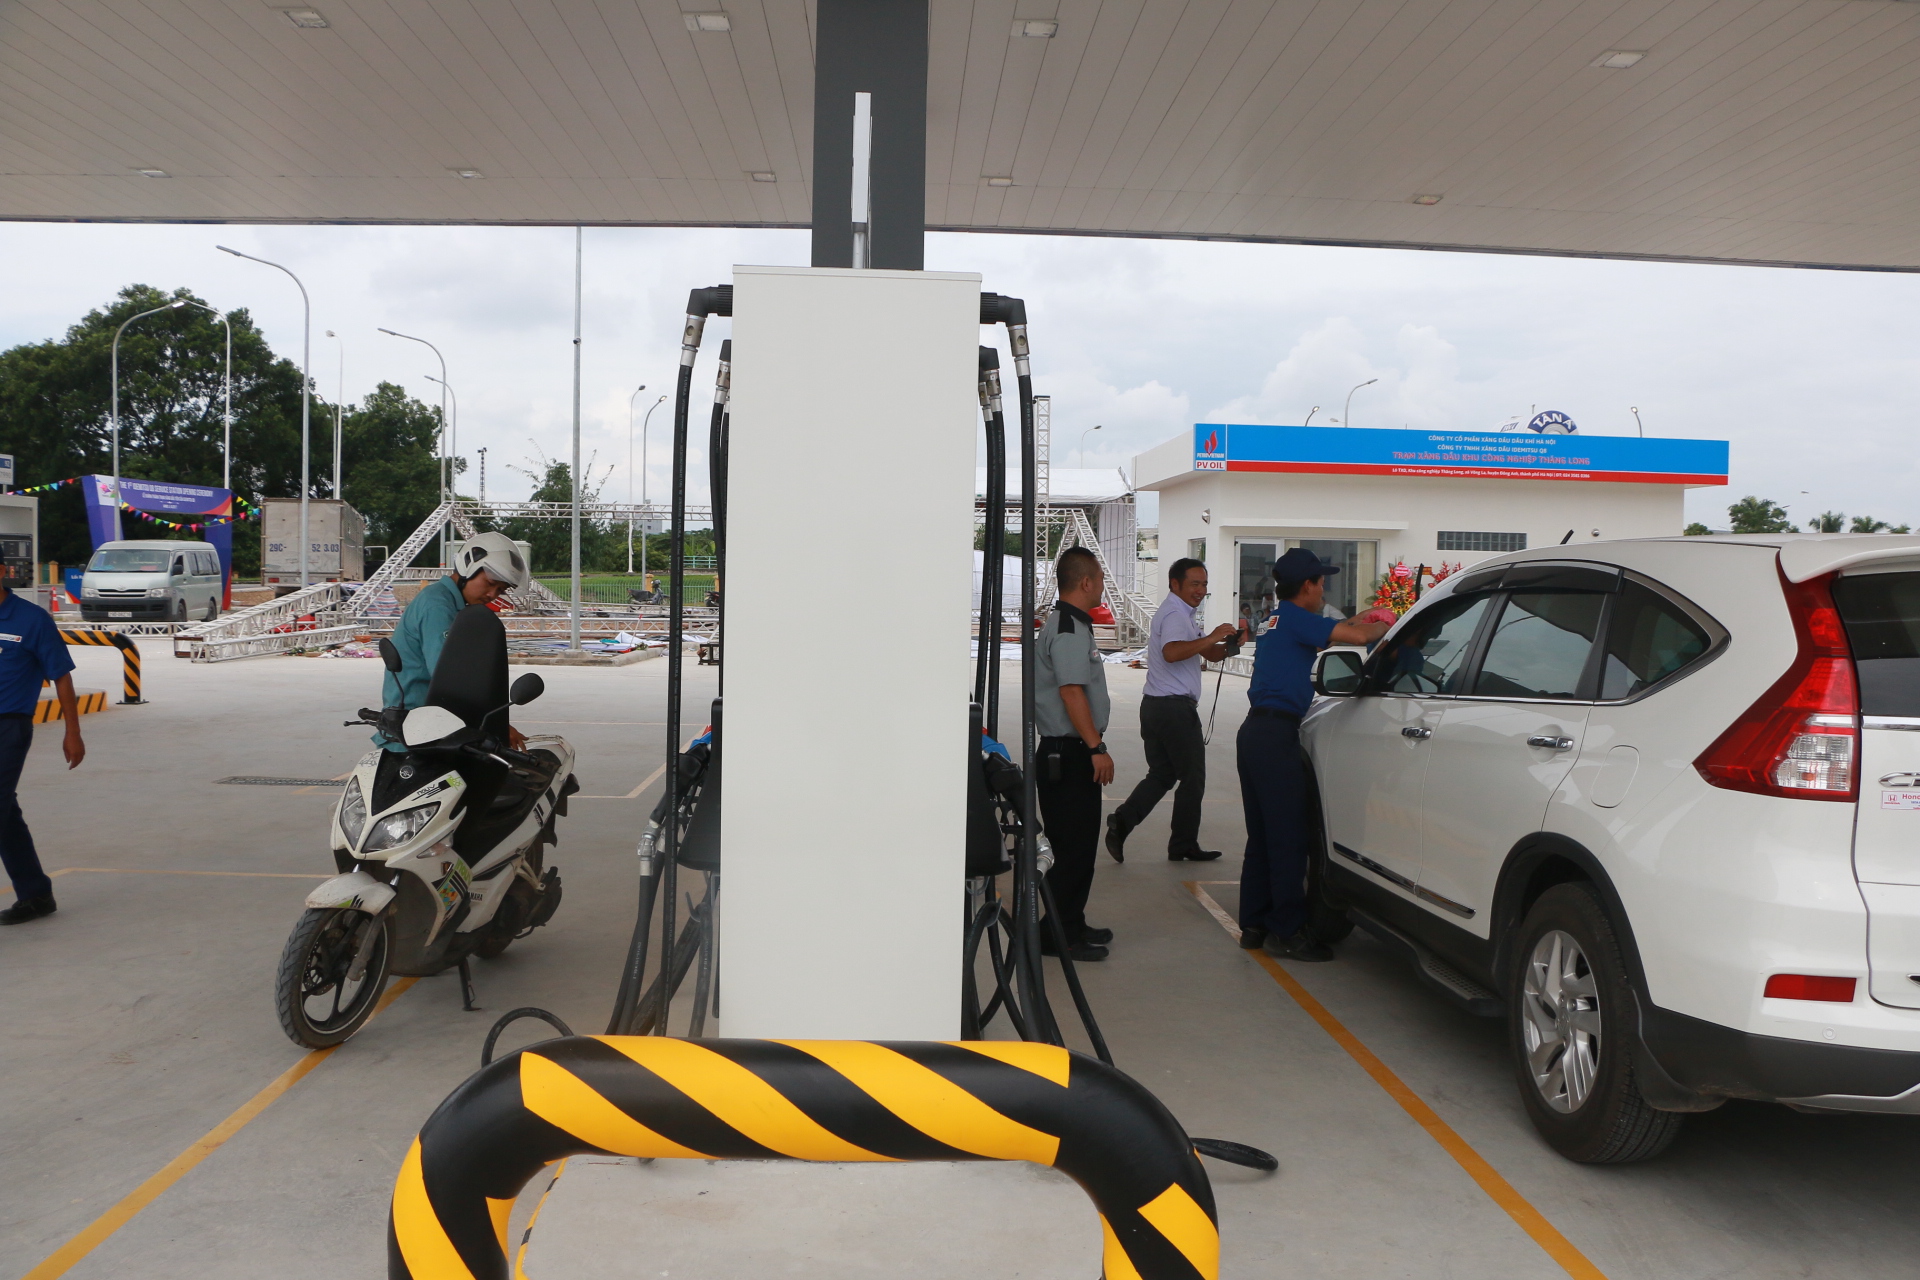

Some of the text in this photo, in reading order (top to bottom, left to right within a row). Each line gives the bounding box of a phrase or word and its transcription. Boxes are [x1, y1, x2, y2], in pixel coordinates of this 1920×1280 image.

[1392, 451, 1416, 461] TRẠM
[1462, 453, 1479, 462] KHU
[1481, 453, 1505, 462] CÔNG
[1506, 454, 1537, 464] NGHIỆP
[1568, 457, 1590, 465] LONG
[1209, 461, 1224, 469] OIL
